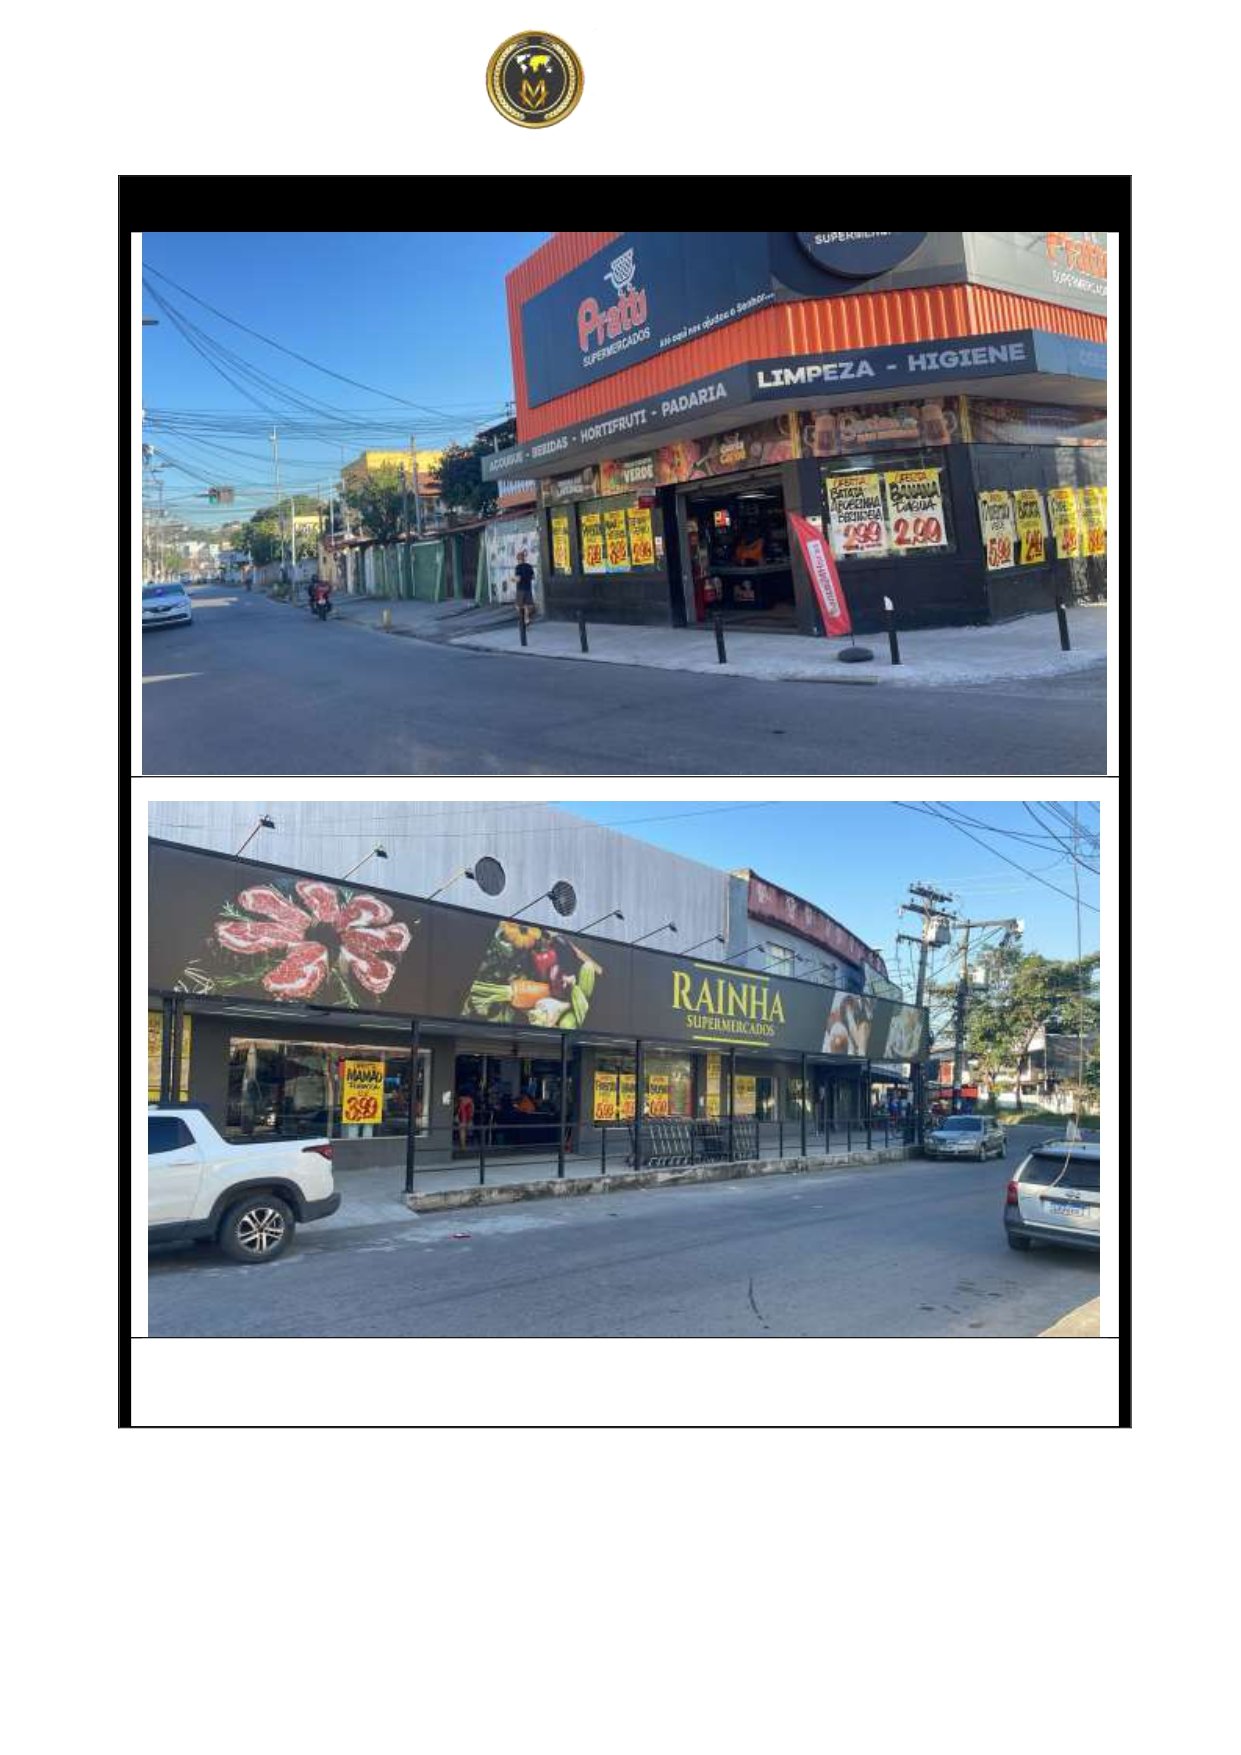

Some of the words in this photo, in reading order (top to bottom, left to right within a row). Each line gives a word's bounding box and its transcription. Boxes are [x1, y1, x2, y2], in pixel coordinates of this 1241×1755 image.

[583, 327, 650, 367] SUPERMERCADOS
[757, 360, 876, 388] LIMPEZA
[908, 342, 1026, 372] HIGIENE
[531, 436, 569, 458] BEBIDAS
[579, 409, 648, 444] HORTIFRUTI
[661, 382, 728, 417] PADARIA
[672, 970, 785, 1024] RAINHA
[686, 1014, 775, 1037] SUPERMERCADOS
